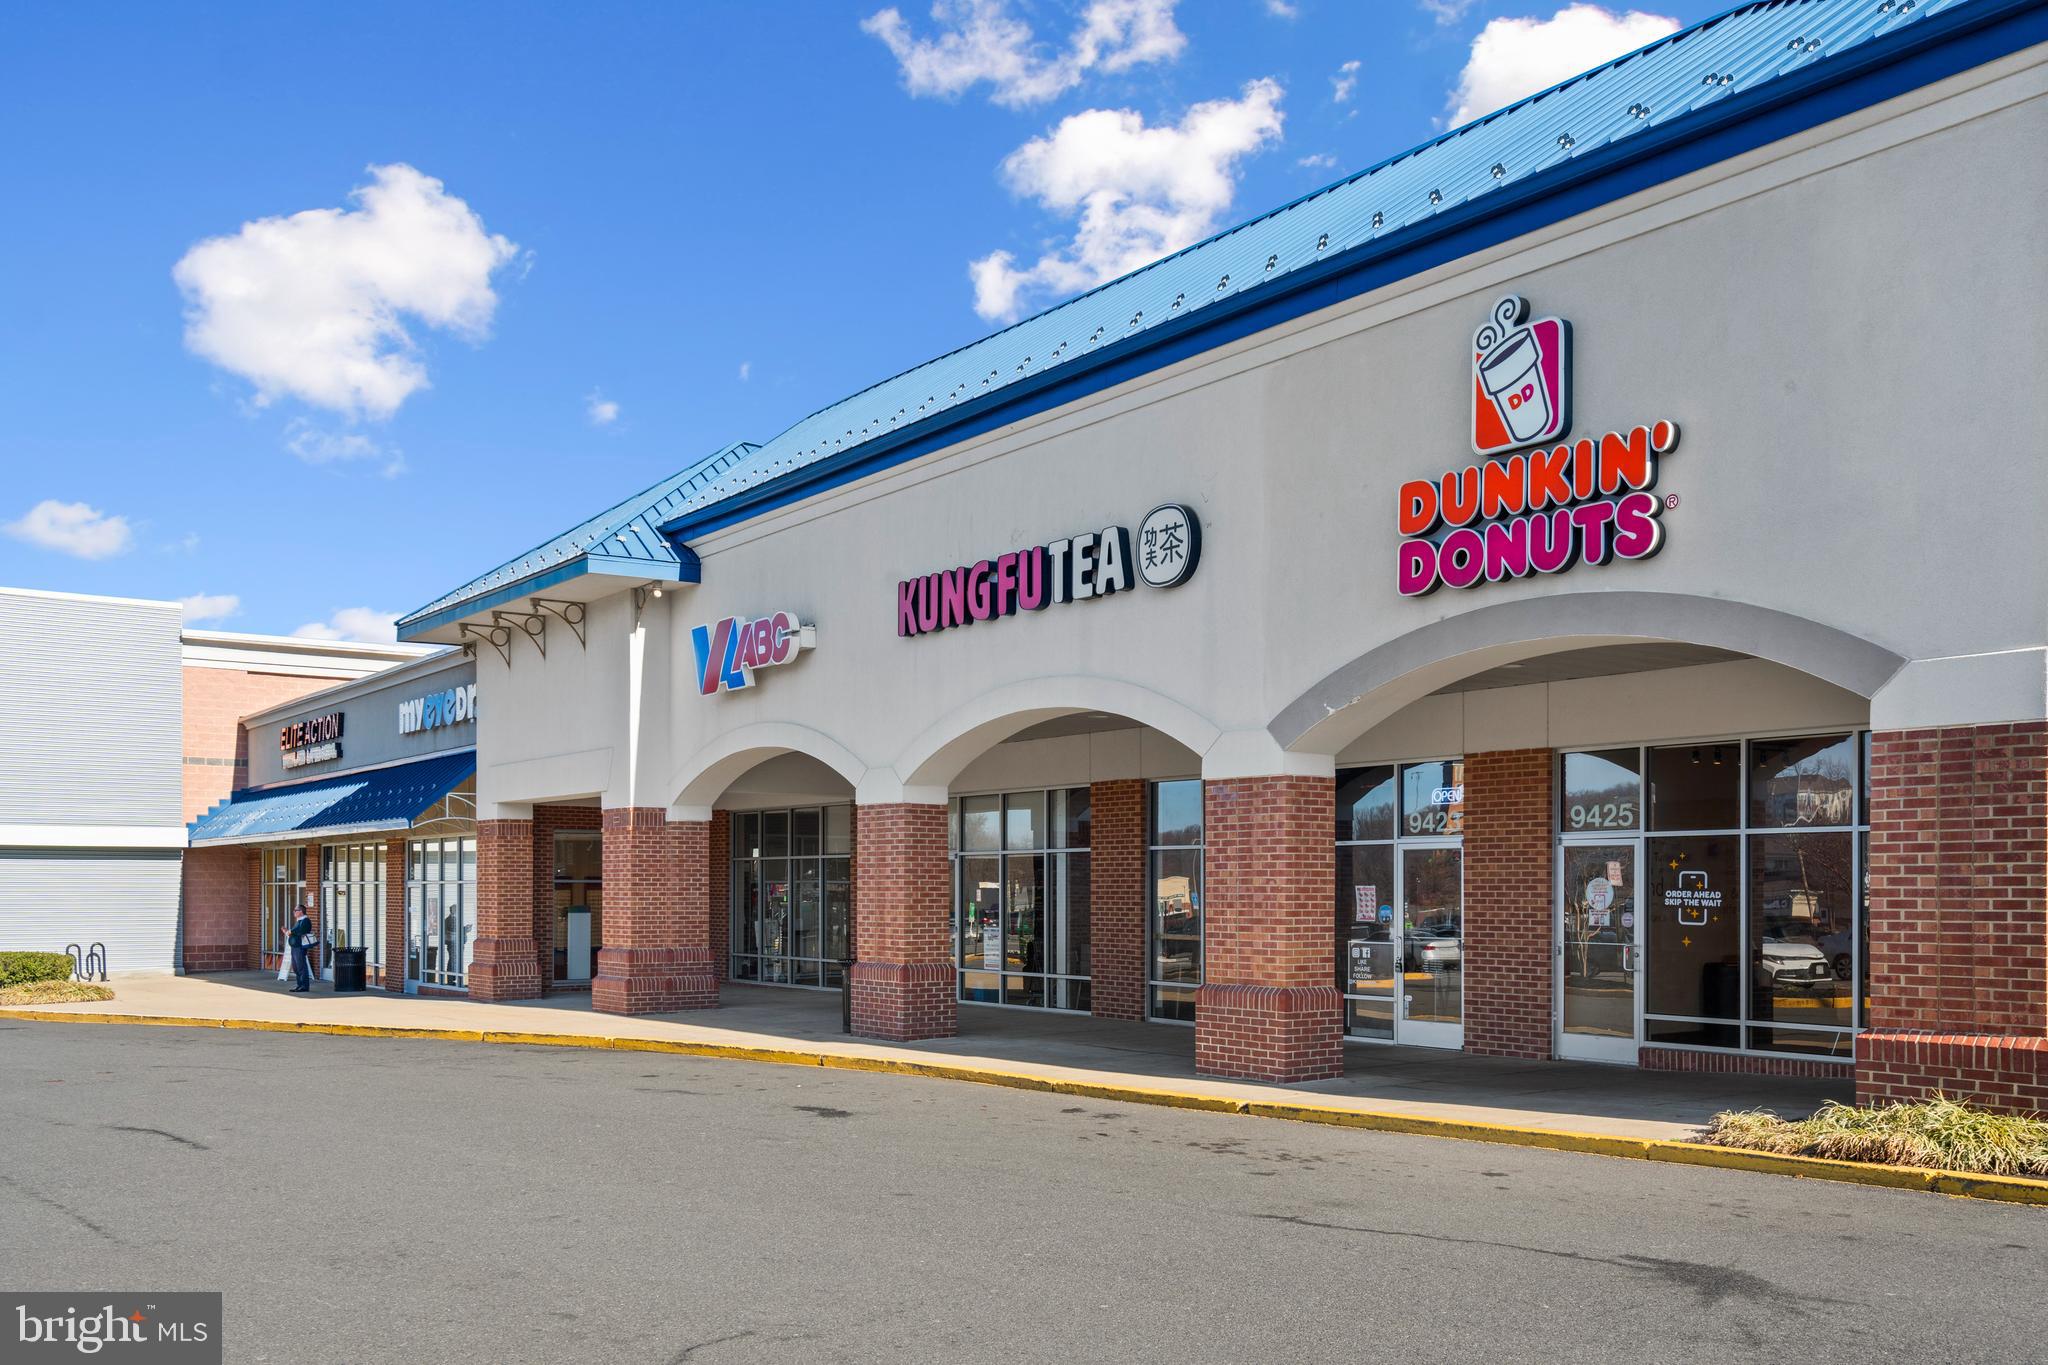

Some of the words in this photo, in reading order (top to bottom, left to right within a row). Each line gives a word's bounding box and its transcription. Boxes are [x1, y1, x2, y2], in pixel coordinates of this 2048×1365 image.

[1507, 383, 1535, 411] DD
[1398, 418, 1676, 537] DUNKIN'
[1397, 492, 1661, 597] DONUTS
[898, 559, 991, 637] KUNG
[997, 546, 1043, 616] FU
[1048, 525, 1126, 603] TEA
[280, 721, 304, 750] ELITE
[304, 712, 339, 745] ACTION
[1433, 789, 1461, 802] OPEN
[1570, 803, 1634, 829] 9425
[1664, 898, 1682, 906] SKIP
[1700, 899, 1723, 907] WAIT
[1665, 890, 1692, 898] ORDER
[1693, 891, 1722, 899] AHEAD
